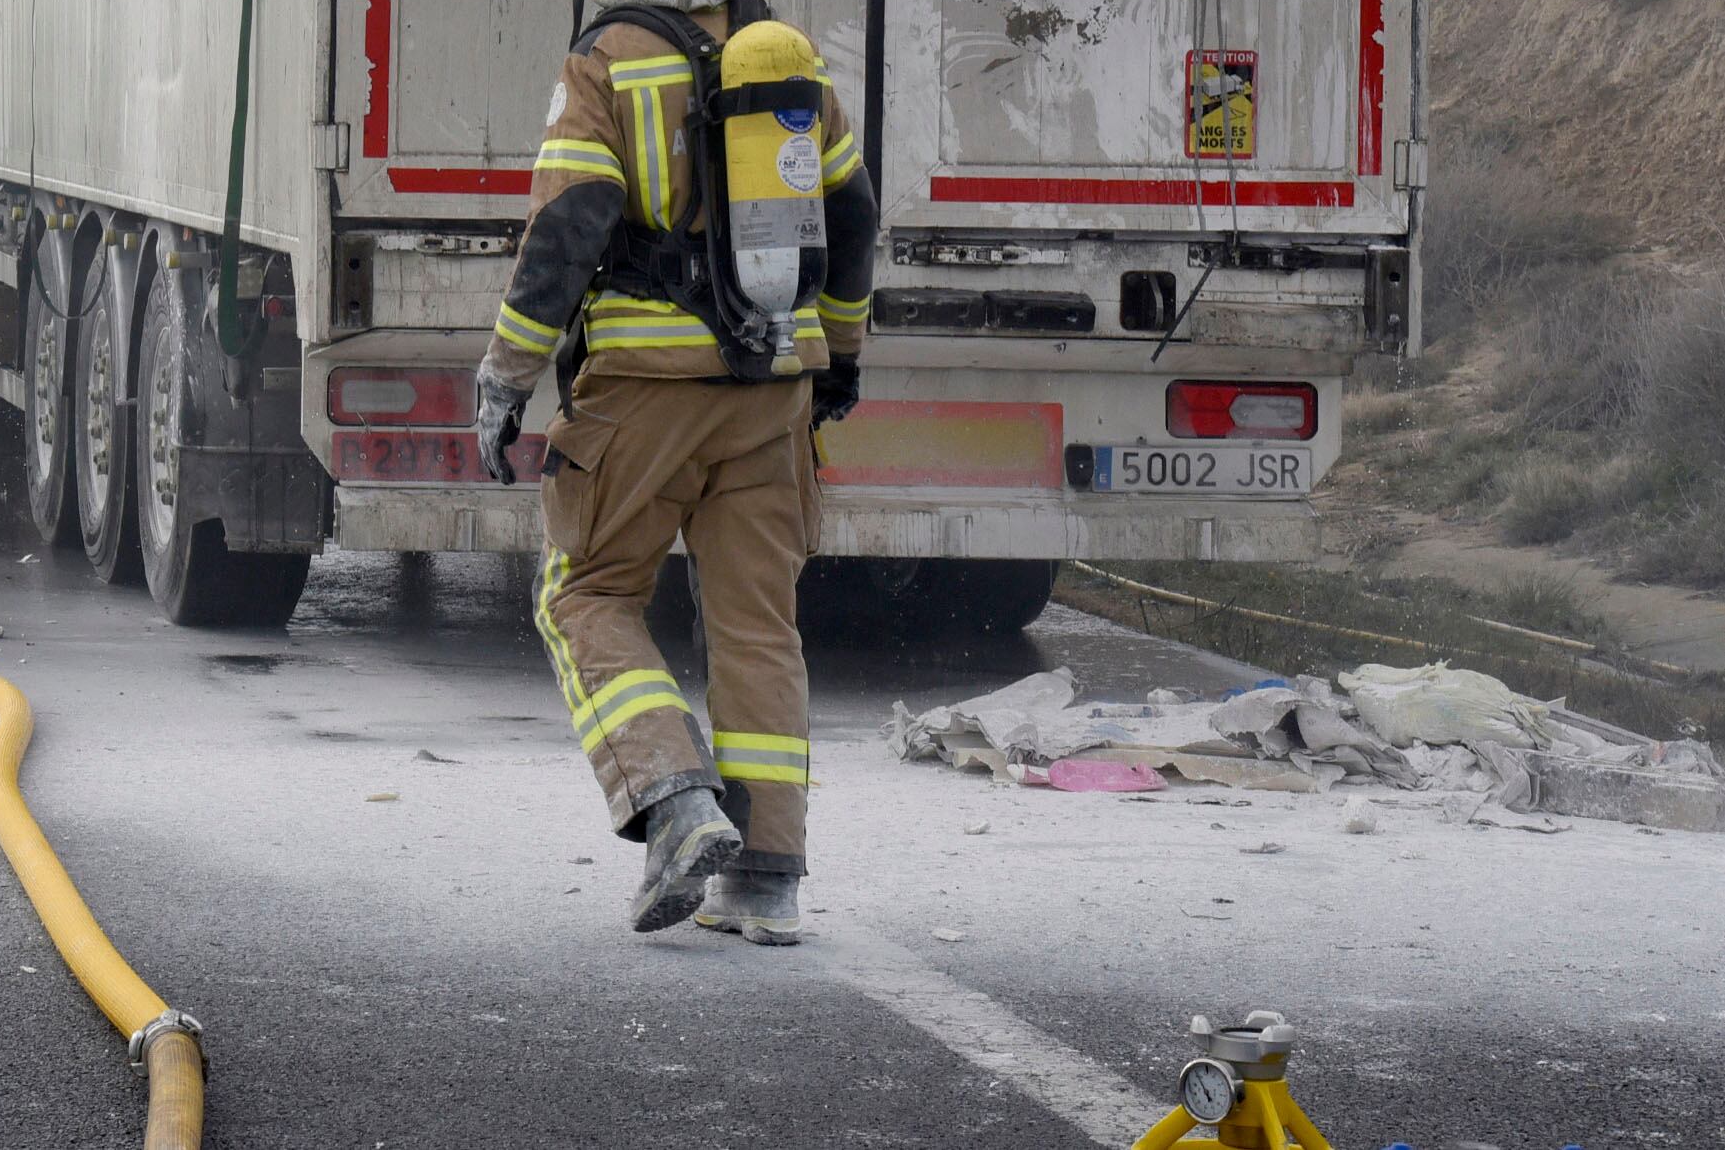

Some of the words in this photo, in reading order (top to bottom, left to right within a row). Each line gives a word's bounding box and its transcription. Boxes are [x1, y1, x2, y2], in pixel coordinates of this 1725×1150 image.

[1199, 126, 1247, 137] ANGES
[1122, 451, 1217, 487] 5002
[1236, 452, 1301, 489] JSR
